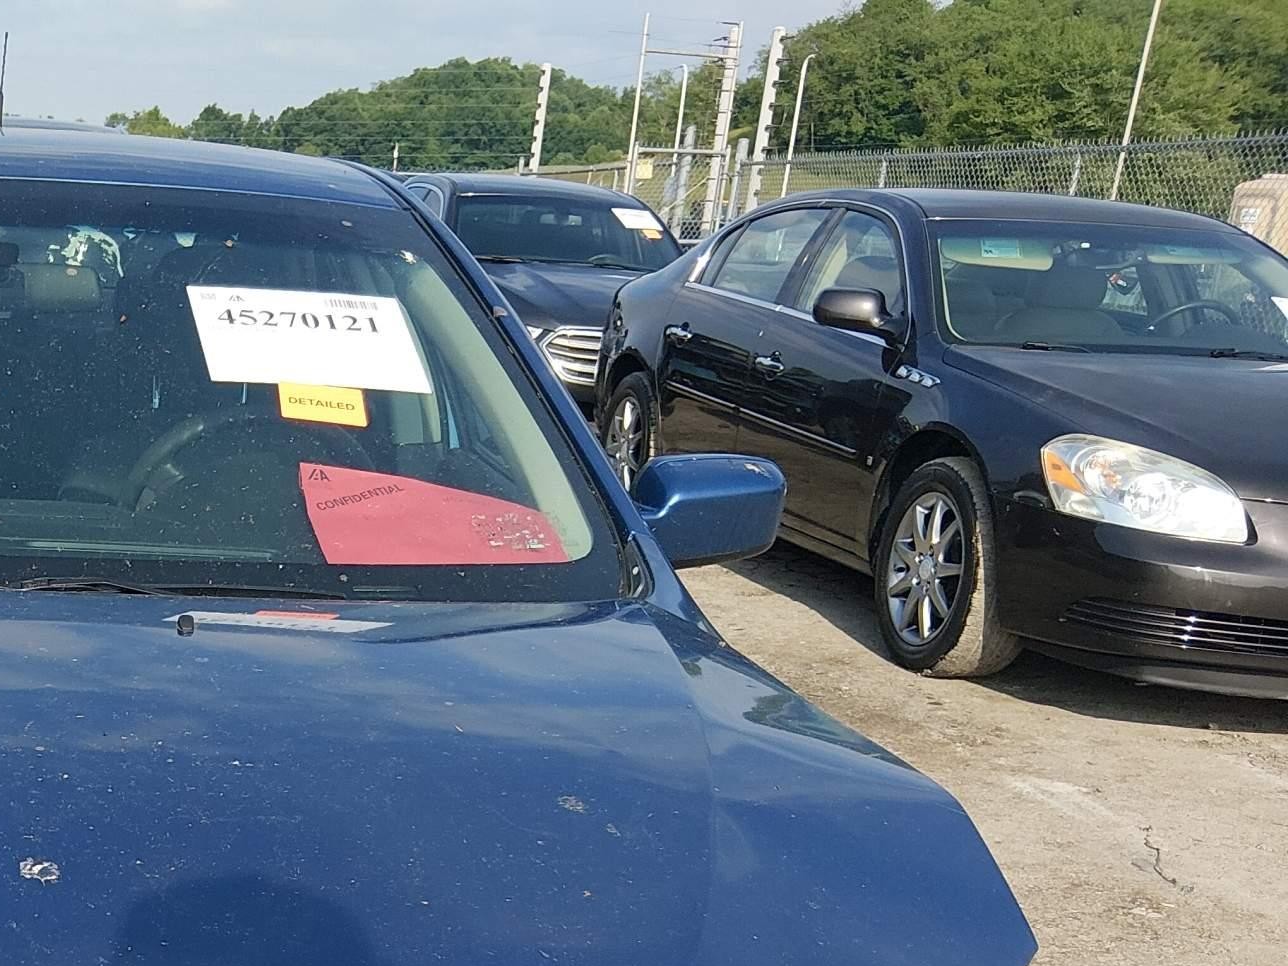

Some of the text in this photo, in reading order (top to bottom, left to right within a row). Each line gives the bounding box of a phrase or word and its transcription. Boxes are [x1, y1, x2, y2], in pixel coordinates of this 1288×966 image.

[216, 308, 380, 334] 45270121
[289, 396, 356, 412] DETAILED
[315, 484, 406, 512] CONFIDENTIAL
